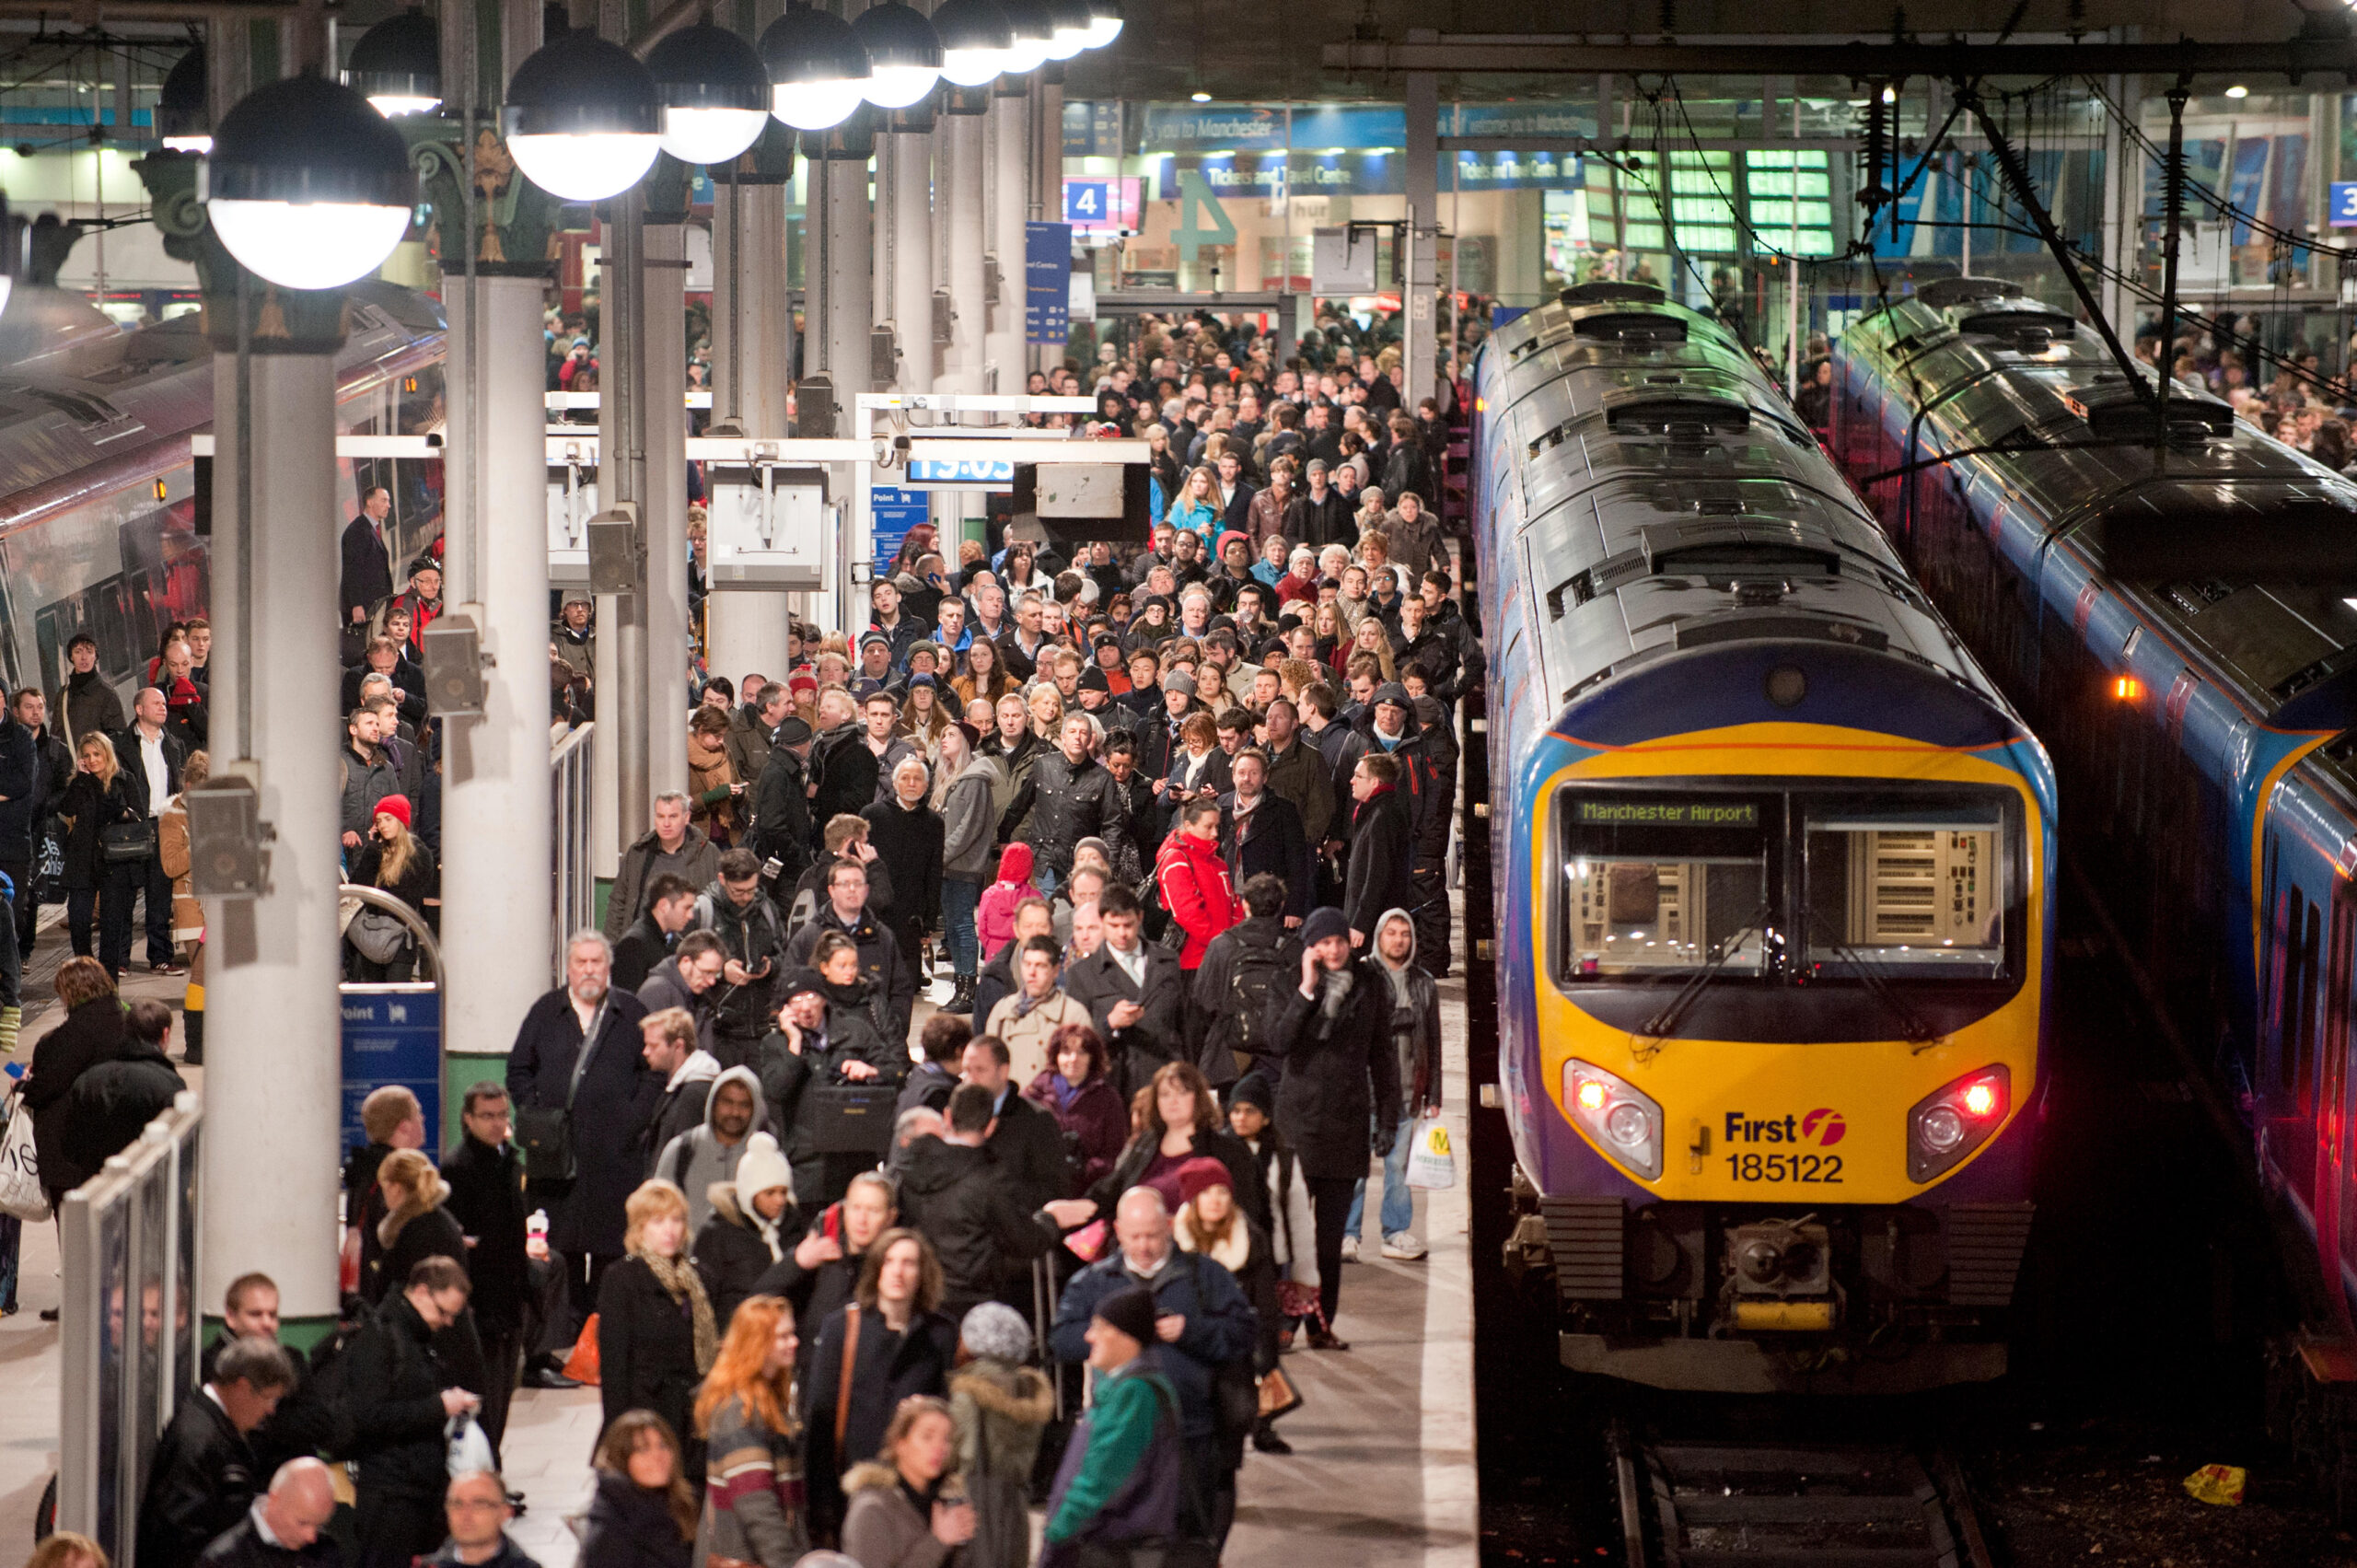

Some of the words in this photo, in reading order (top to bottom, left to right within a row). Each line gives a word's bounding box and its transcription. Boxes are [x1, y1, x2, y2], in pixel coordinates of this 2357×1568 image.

[1197, 118, 1273, 137] Manchester
[1208, 168, 1253, 186] Tickets
[1254, 166, 1279, 185] and
[1314, 166, 1352, 185] Centre
[1075, 188, 1097, 215] 4
[2341, 187, 2357, 215] 3
[873, 494, 895, 503] Point
[1583, 803, 1685, 820] Manchester
[1690, 805, 1753, 822] Airport
[1724, 1111, 1797, 1143] First
[1725, 1154, 1843, 1183] 185122
